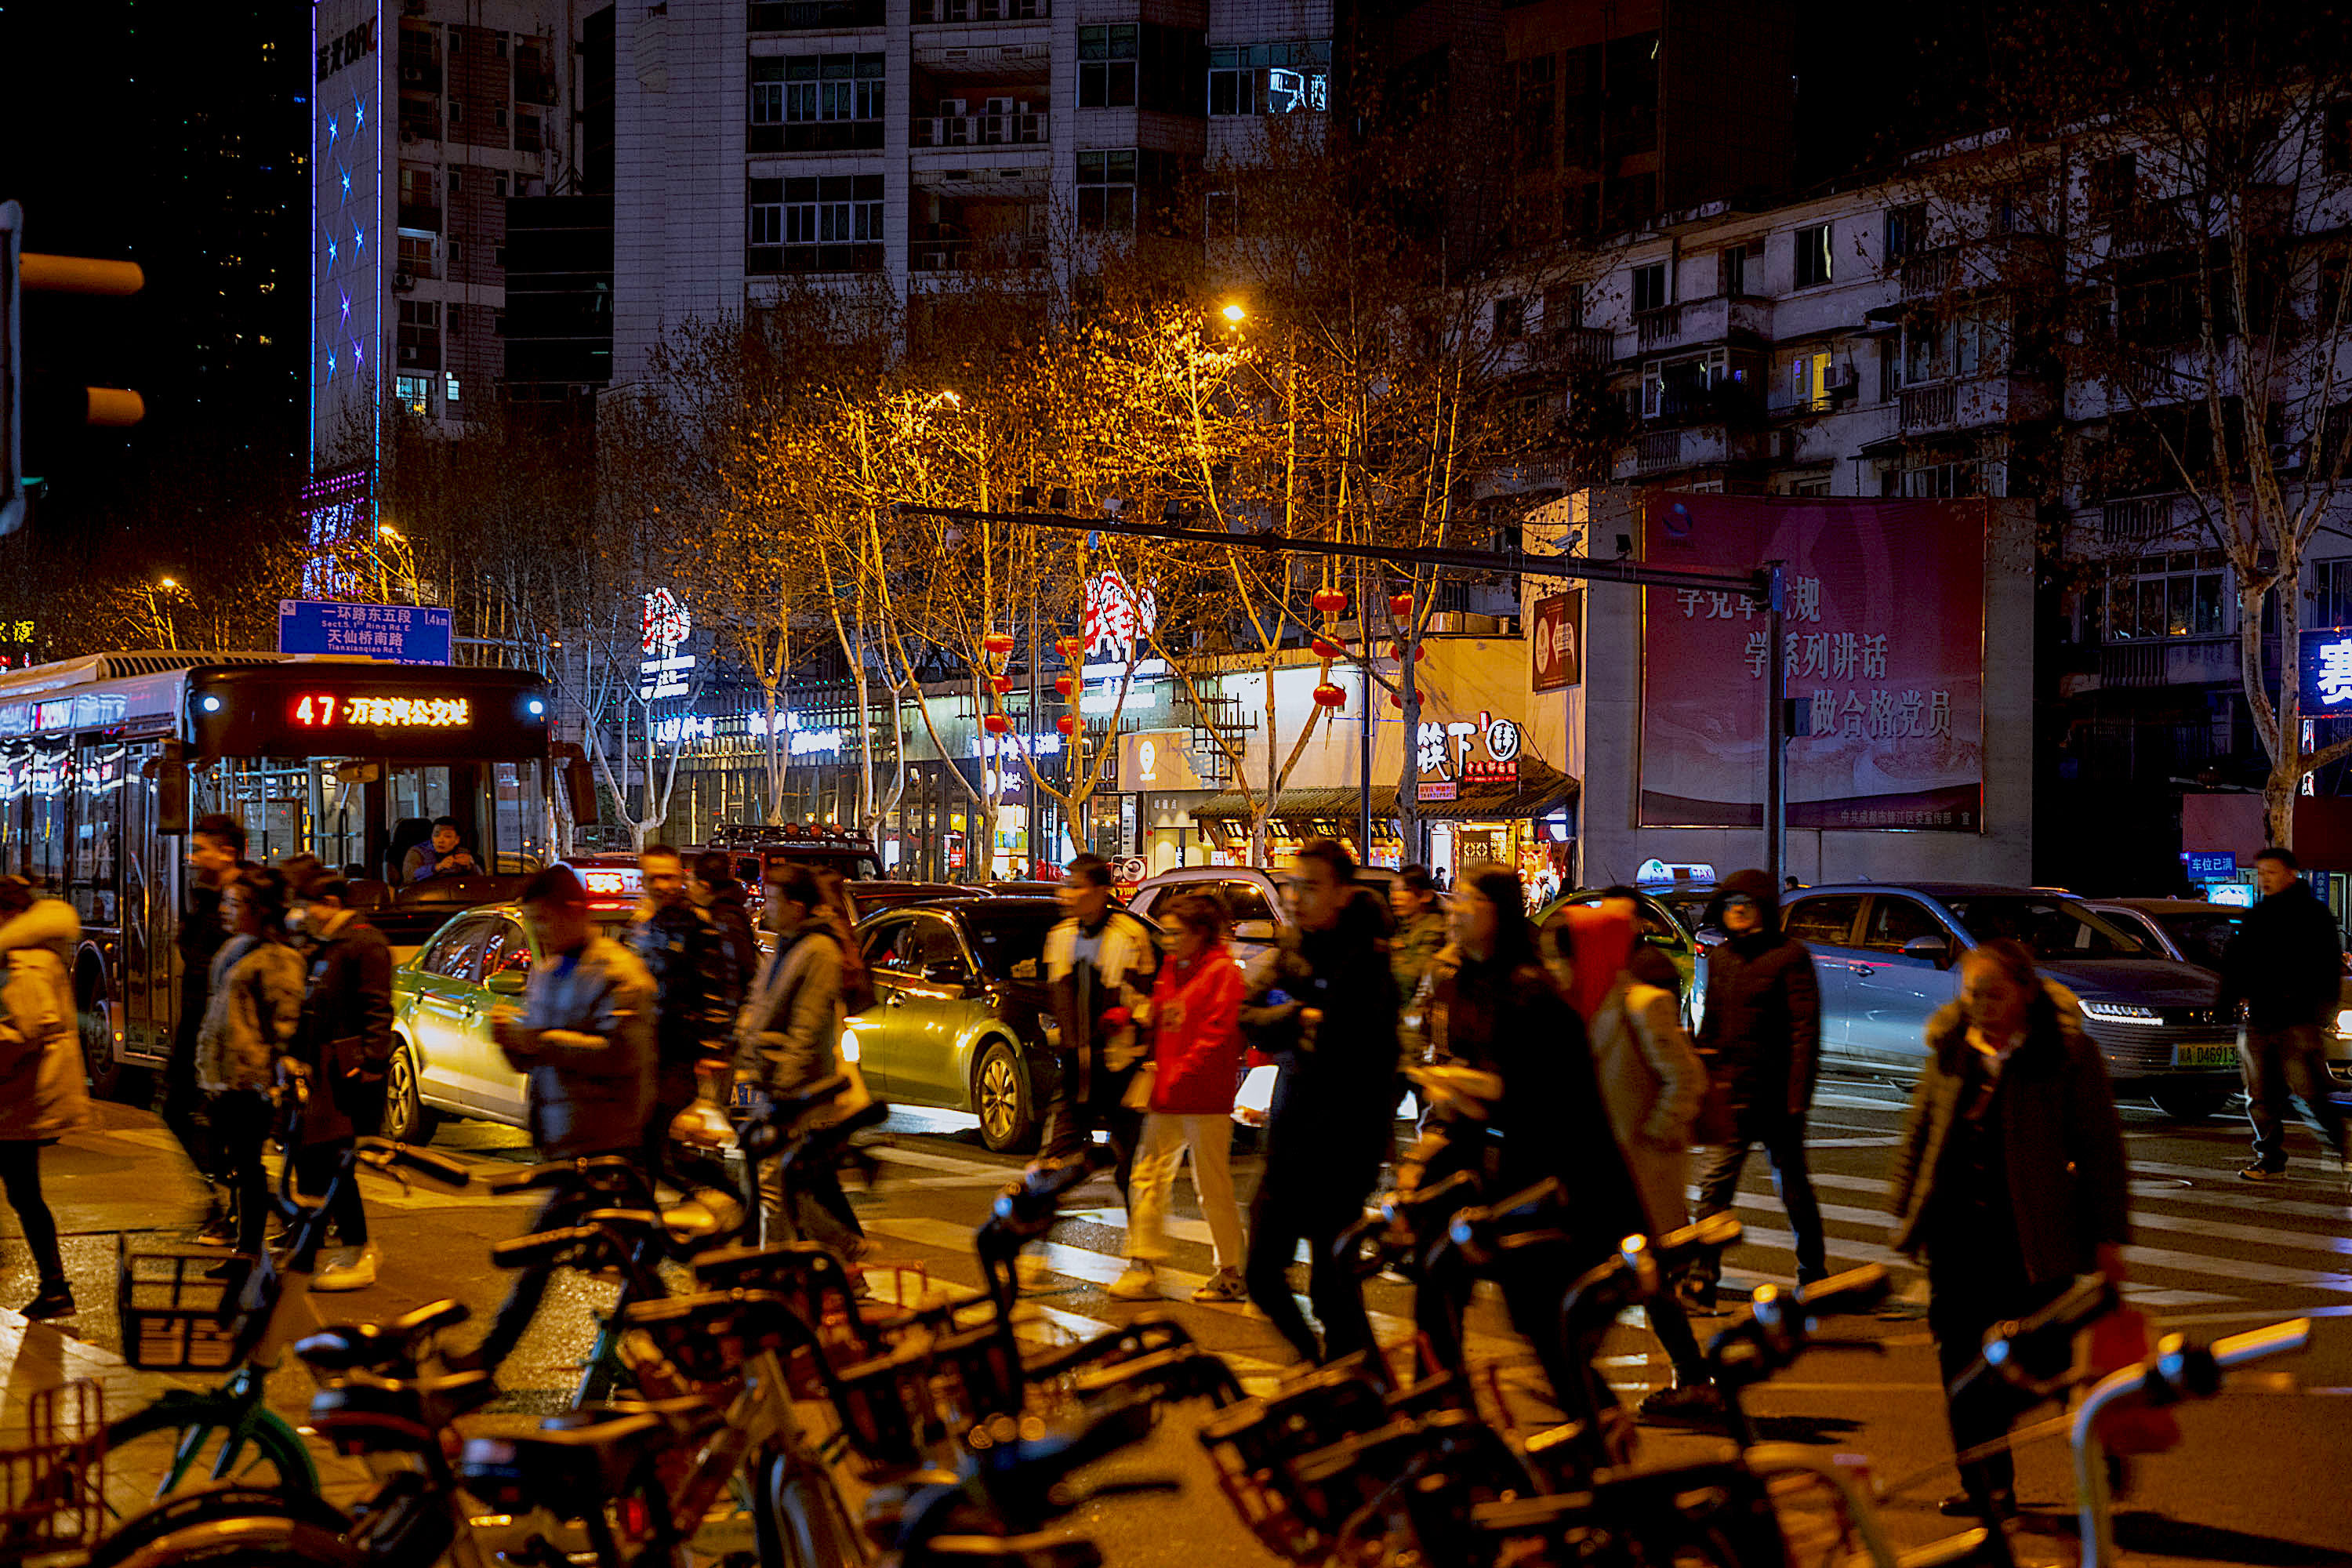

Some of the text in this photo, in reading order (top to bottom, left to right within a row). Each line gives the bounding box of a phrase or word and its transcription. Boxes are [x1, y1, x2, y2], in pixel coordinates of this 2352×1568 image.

[322, 606, 412, 624] 一环路东五段
[366, 622, 387, 631] Ring
[328, 629, 403, 647] 天仙桥南路
[328, 644, 381, 653] Tianxianqiao
[296, 696, 335, 725] 47
[1810, 688, 1951, 738] 做合格党员
[2191, 857, 2233, 872] 车位已满
[1693, 869, 1714, 879] TAXI
